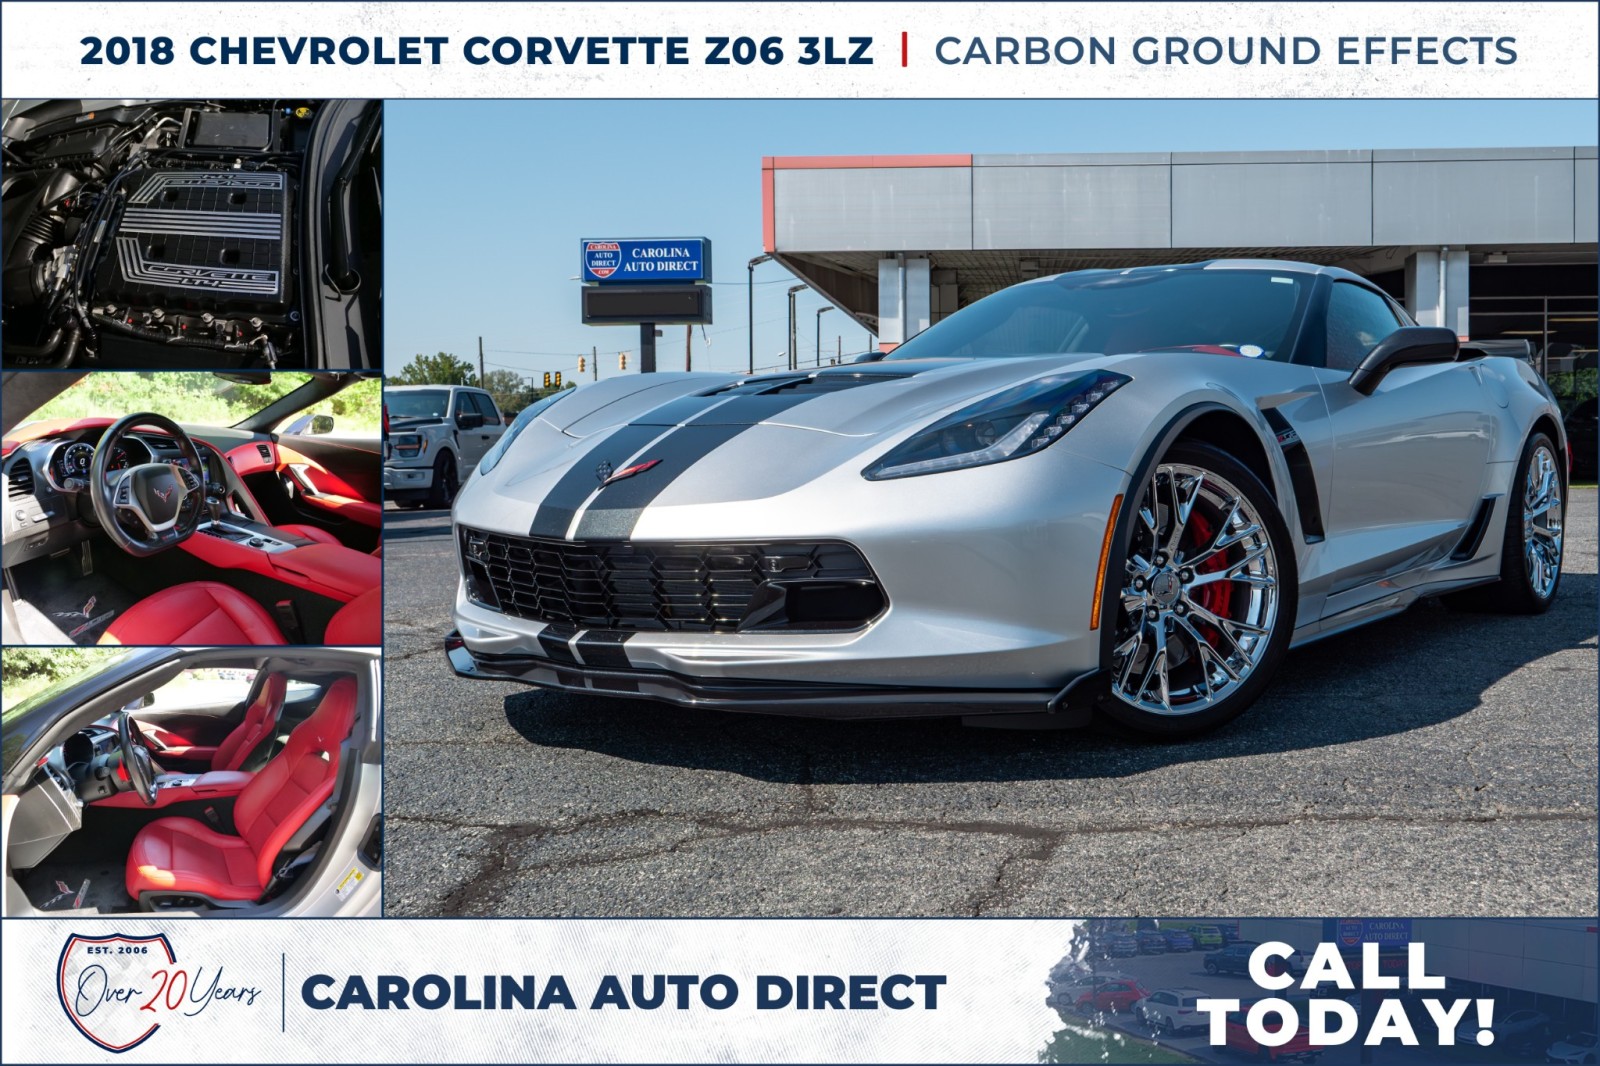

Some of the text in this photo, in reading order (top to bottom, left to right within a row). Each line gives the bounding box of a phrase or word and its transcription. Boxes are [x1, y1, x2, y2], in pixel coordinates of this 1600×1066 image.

[632, 247, 690, 258] CAROLINA
[623, 261, 699, 272] AUTO DIRECT
[147, 265, 272, 281] CORVETTE
[181, 278, 220, 287] LT4
[1369, 922, 1404, 930] CAROLINA
[1364, 933, 1383, 941] AUTO
[1384, 932, 1409, 940] DIRECT
